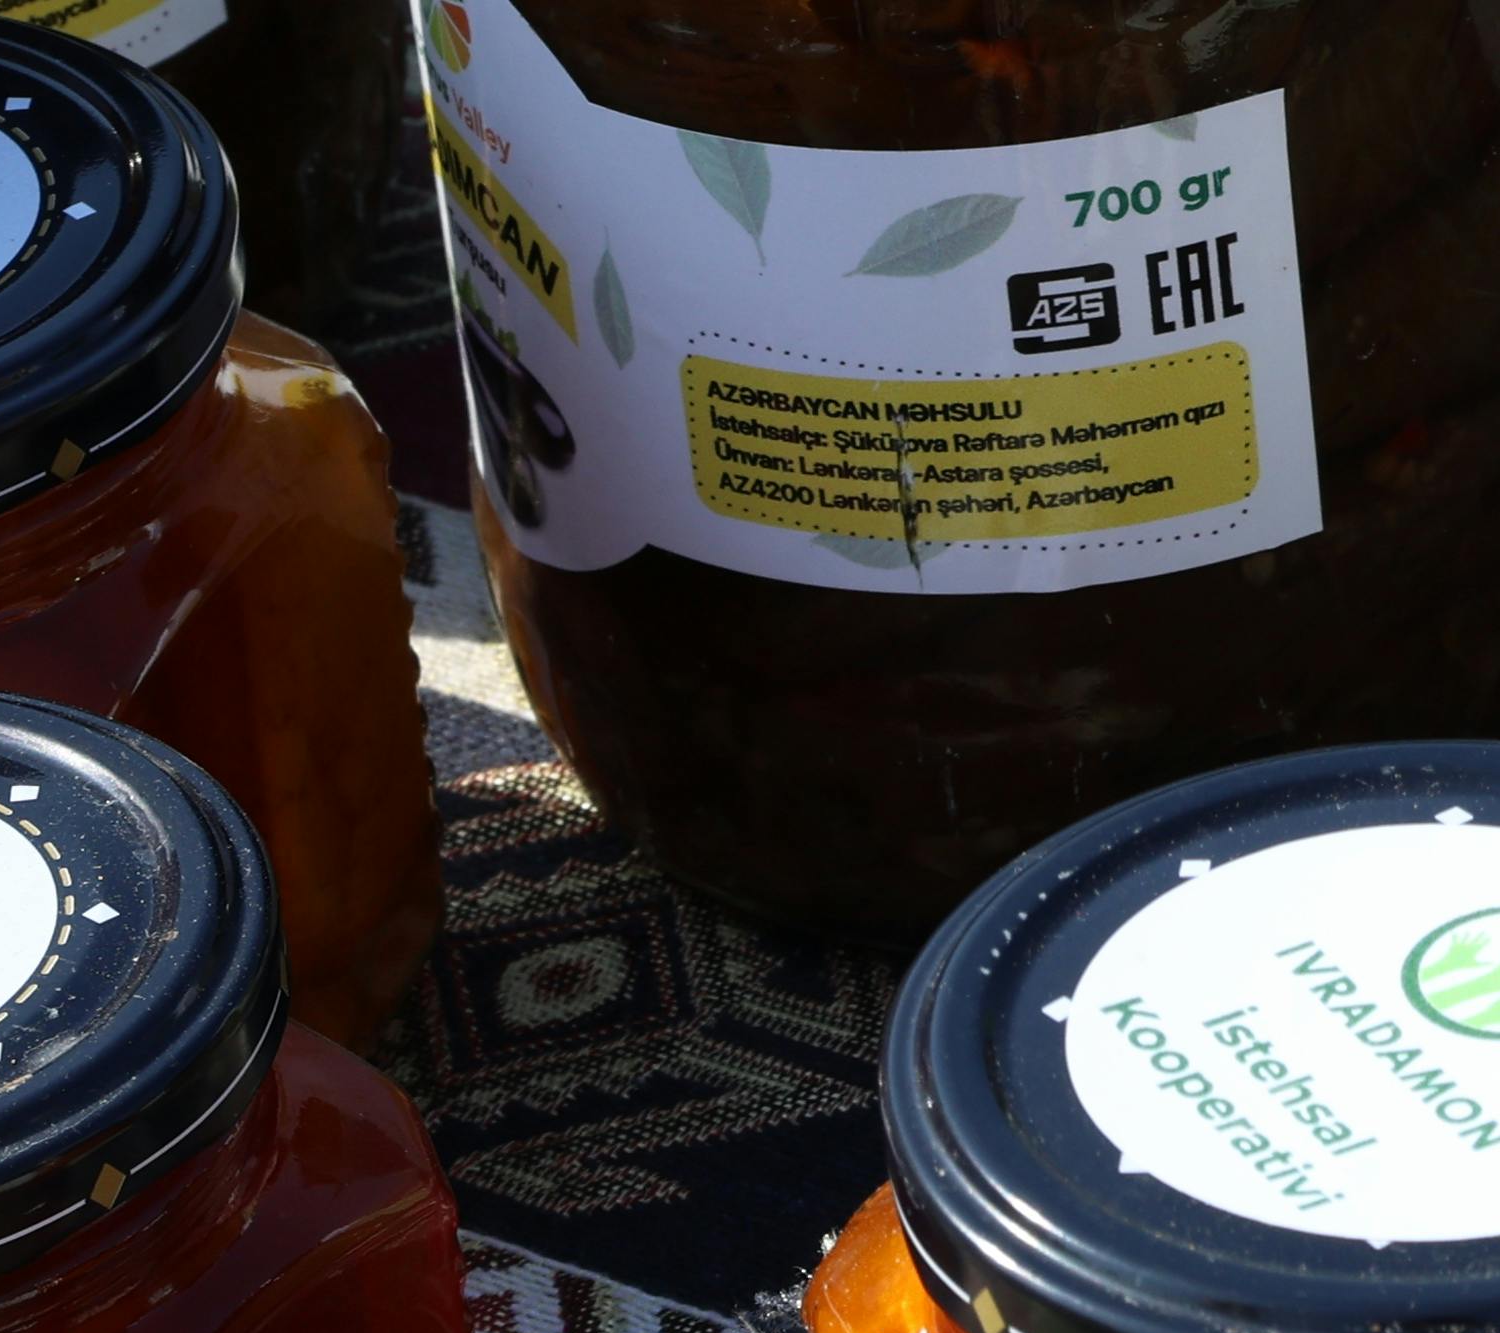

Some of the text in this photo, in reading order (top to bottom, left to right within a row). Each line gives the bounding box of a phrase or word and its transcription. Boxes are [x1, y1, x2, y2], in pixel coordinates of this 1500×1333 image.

[451, 87, 511, 164] Valley
[1064, 166, 1231, 228] 700 gr
[1145, 232, 1245, 336] EAC
[707, 380, 1023, 423] AZƏRBAYCAN MƏHSULU
[709, 405, 828, 450] İstehsalçı:
[953, 430, 1045, 452] Rəftarə
[1050, 411, 1179, 447] Məhərrəm
[1183, 400, 1226, 427] qızı
[714, 437, 1110, 486] Ünvan: Lənkəra-Astara şossesi,
[719, 472, 815, 505] AZ4200
[937, 492, 1021, 518] şəhəri,
[1026, 475, 1174, 511] Azərbaycan
[1099, 995, 1347, 1212] Kooperativi
[1202, 1005, 1378, 1157] İstehsal
